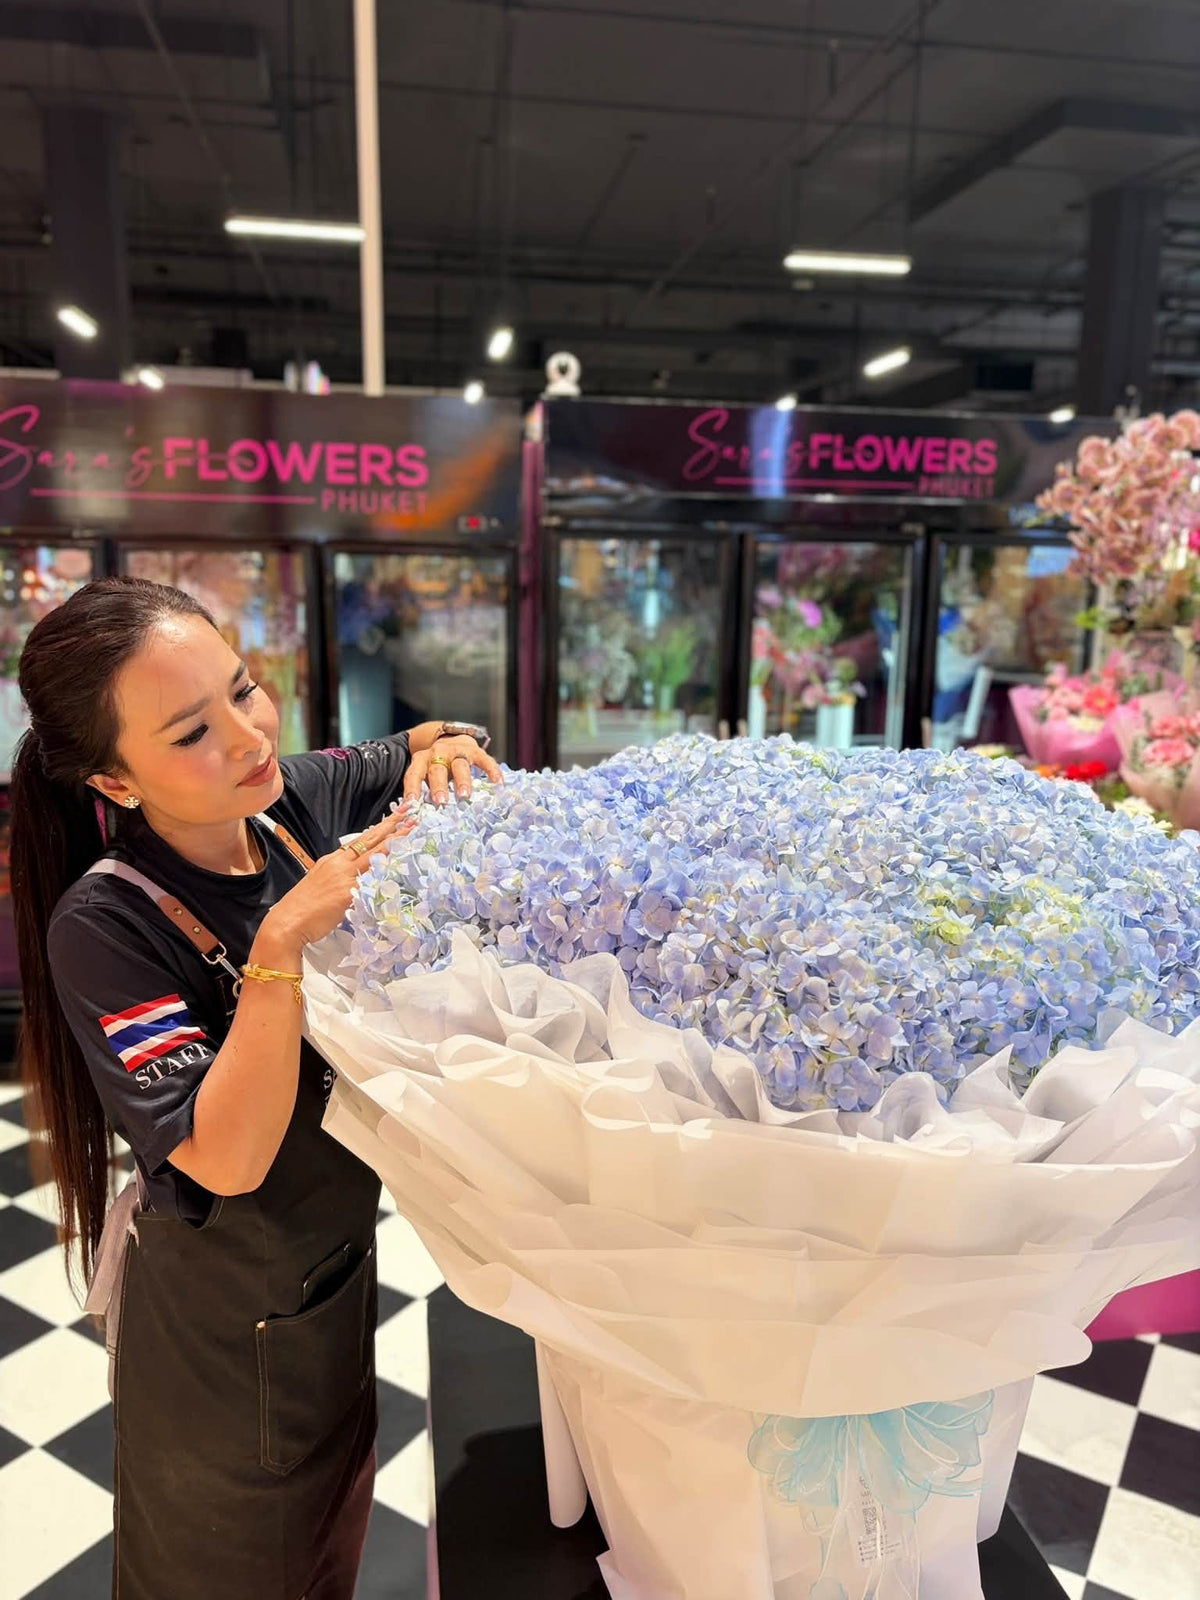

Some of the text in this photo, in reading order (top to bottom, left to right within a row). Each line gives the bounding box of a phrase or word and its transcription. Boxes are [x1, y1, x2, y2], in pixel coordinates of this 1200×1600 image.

[163, 437, 429, 487] FLOWERS
[808, 433, 998, 475] FLOWERS
[320, 488, 428, 515] PHUKET
